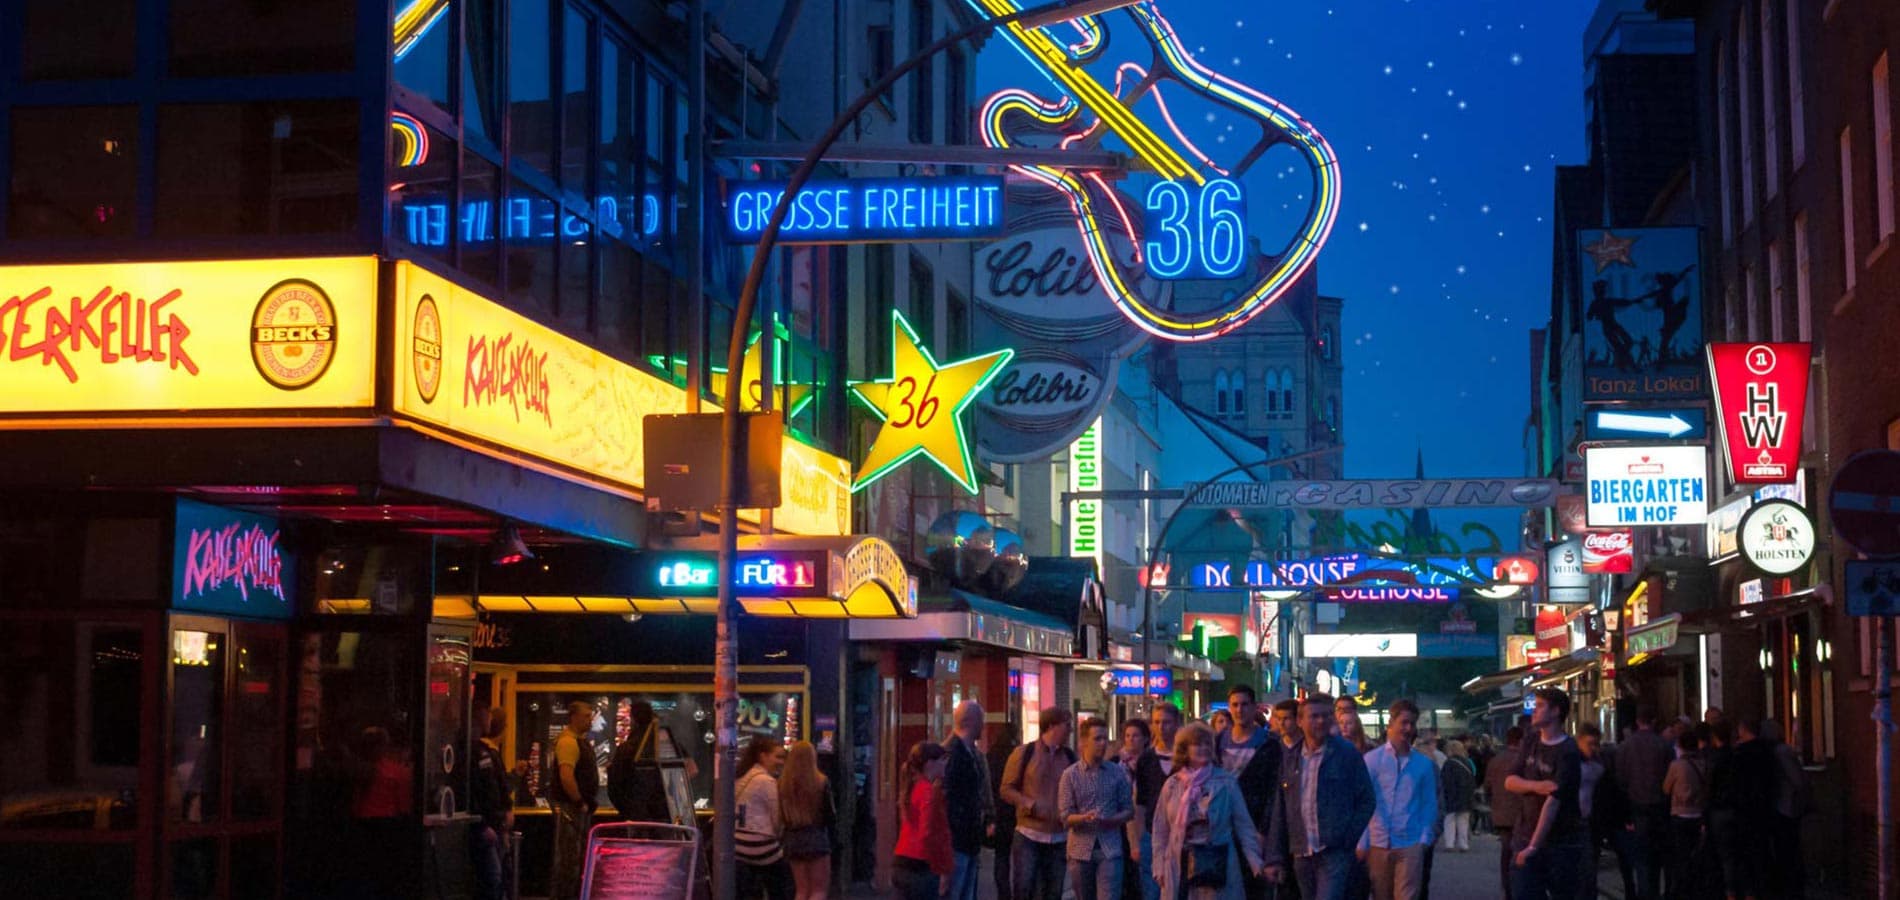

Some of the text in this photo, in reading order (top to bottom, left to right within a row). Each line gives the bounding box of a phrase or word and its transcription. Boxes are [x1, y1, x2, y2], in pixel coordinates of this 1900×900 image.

[734, 186, 999, 231] GROSSE FREIHEIT
[1146, 178, 1244, 277] 36
[258, 324, 331, 342] BECK'S
[1755, 352, 1767, 366] 1
[463, 331, 552, 429] KAISERKELLER
[989, 370, 1090, 406] Colibri
[1590, 374, 1700, 394] Tanz Lokal
[890, 375, 940, 430] 36
[1294, 481, 1552, 506] CASINO
[1590, 477, 1704, 504] BIERGARTEN
[1617, 506, 1677, 522] IM HOF
[183, 522, 286, 602] KAISERKELLER
[1755, 549, 1806, 560] HOLSTEN
[674, 562, 712, 586] Bar
[743, 559, 788, 585] FÜR
[794, 565, 806, 585] 1
